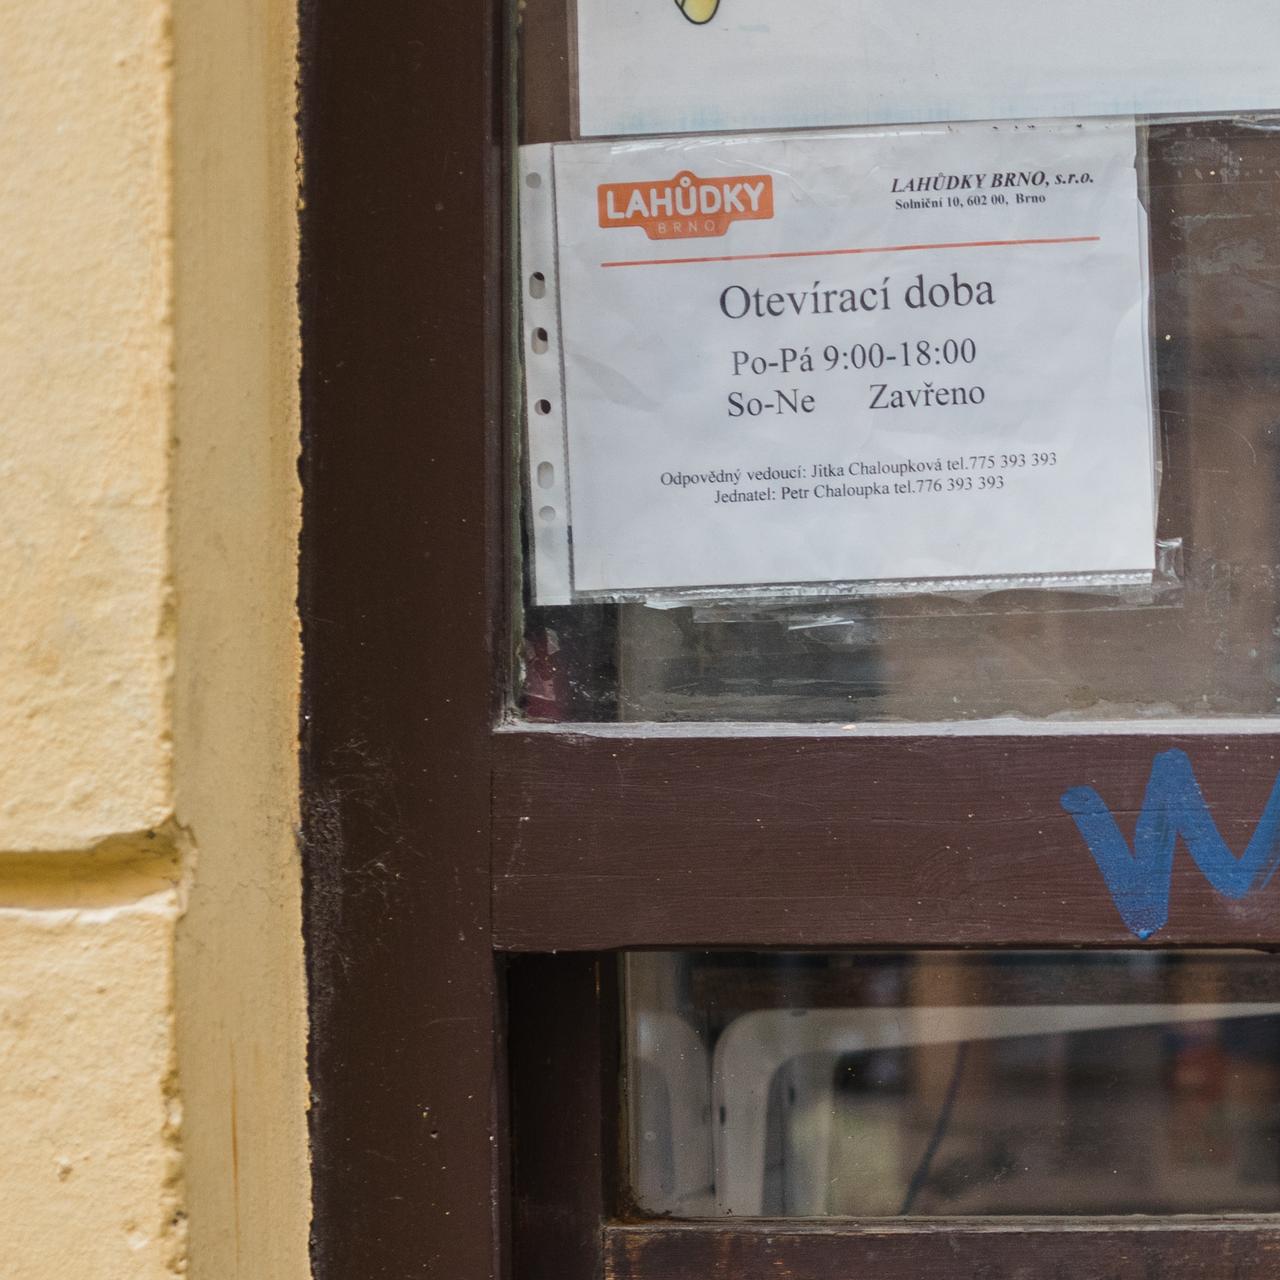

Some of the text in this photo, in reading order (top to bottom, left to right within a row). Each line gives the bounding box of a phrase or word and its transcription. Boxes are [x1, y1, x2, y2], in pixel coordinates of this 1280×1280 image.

[606, 176, 765, 220] LAHŮDKY
[891, 170, 1095, 194] LAHŮDKY BRNO, s.r.o.
[895, 192, 1047, 210] Solniční 10, 602 00, Brno
[658, 219, 716, 234] BRNO
[718, 271, 997, 320] Otevírací doba
[731, 337, 977, 376] Po-Pá 9:00-18:00
[727, 381, 986, 418] So-Ne Zavřeno
[660, 452, 1057, 488] Odpovědný vedoucí: Jitka Chaloupková tel.775 393 393
[714, 475, 1004, 504] Jednatel: Petr Chaloupka tel.776 393 393
